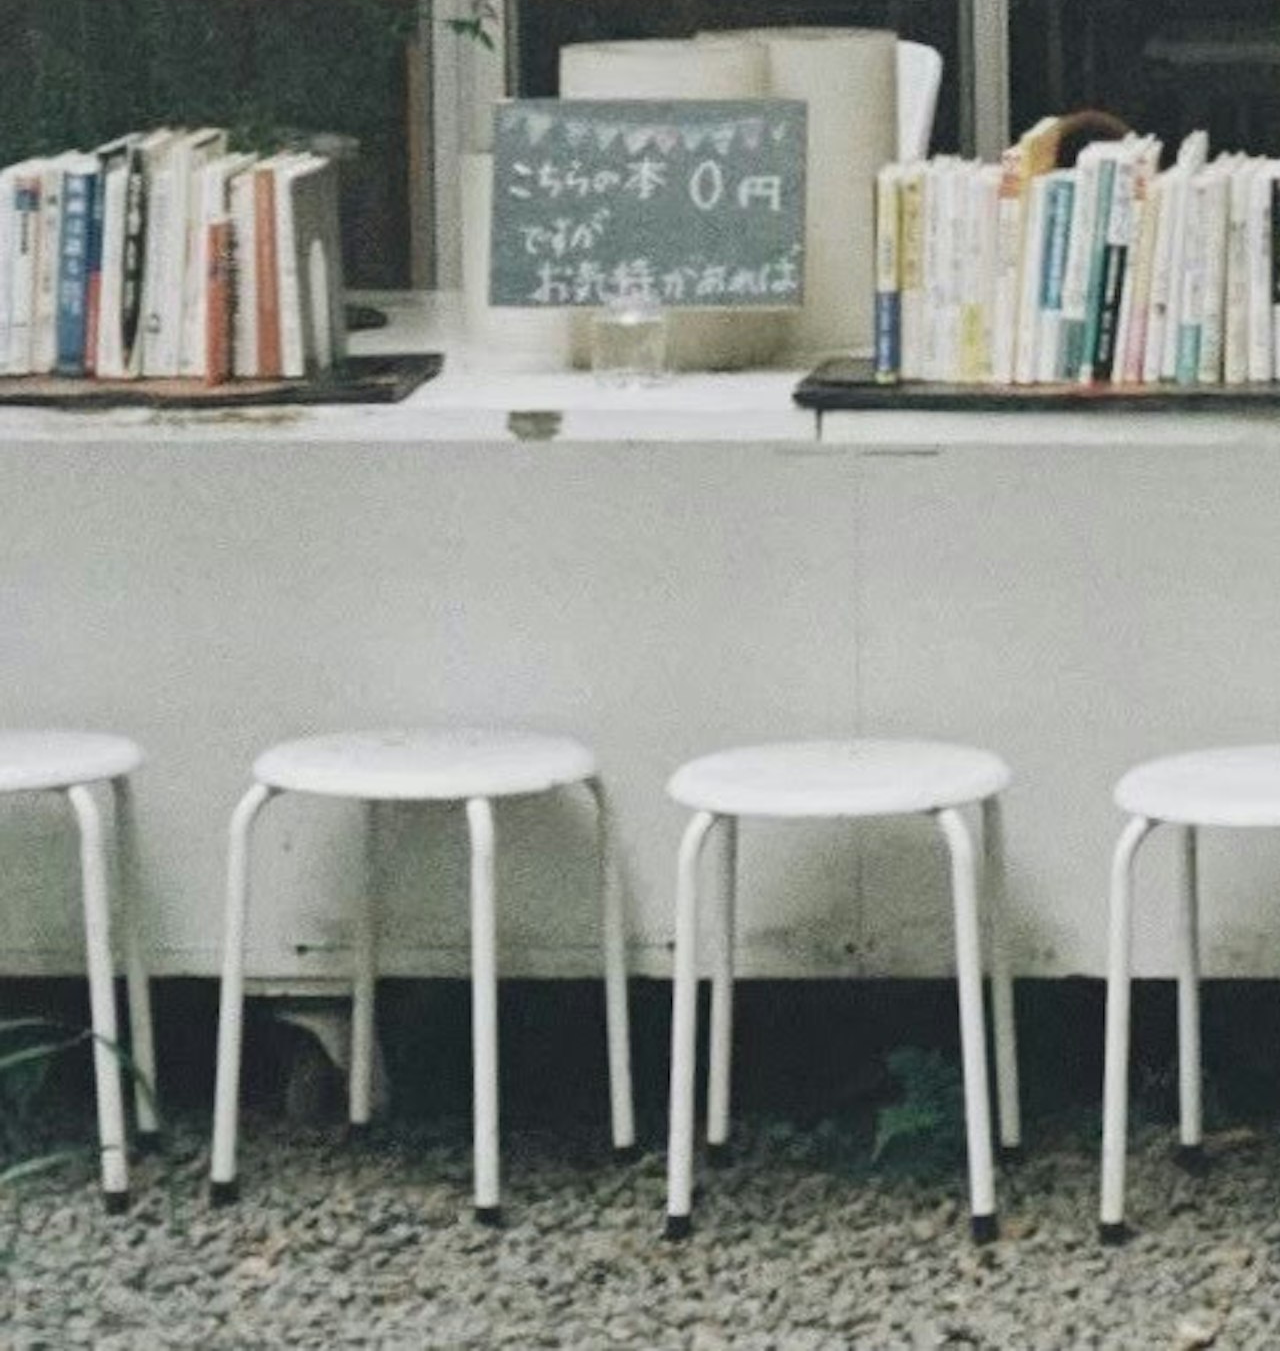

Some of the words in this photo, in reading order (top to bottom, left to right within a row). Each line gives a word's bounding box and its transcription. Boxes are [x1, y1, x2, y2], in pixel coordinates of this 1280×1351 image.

[509, 157, 668, 200] こちらの本
[689, 159, 783, 211] 0円
[521, 207, 610, 259] ですが
